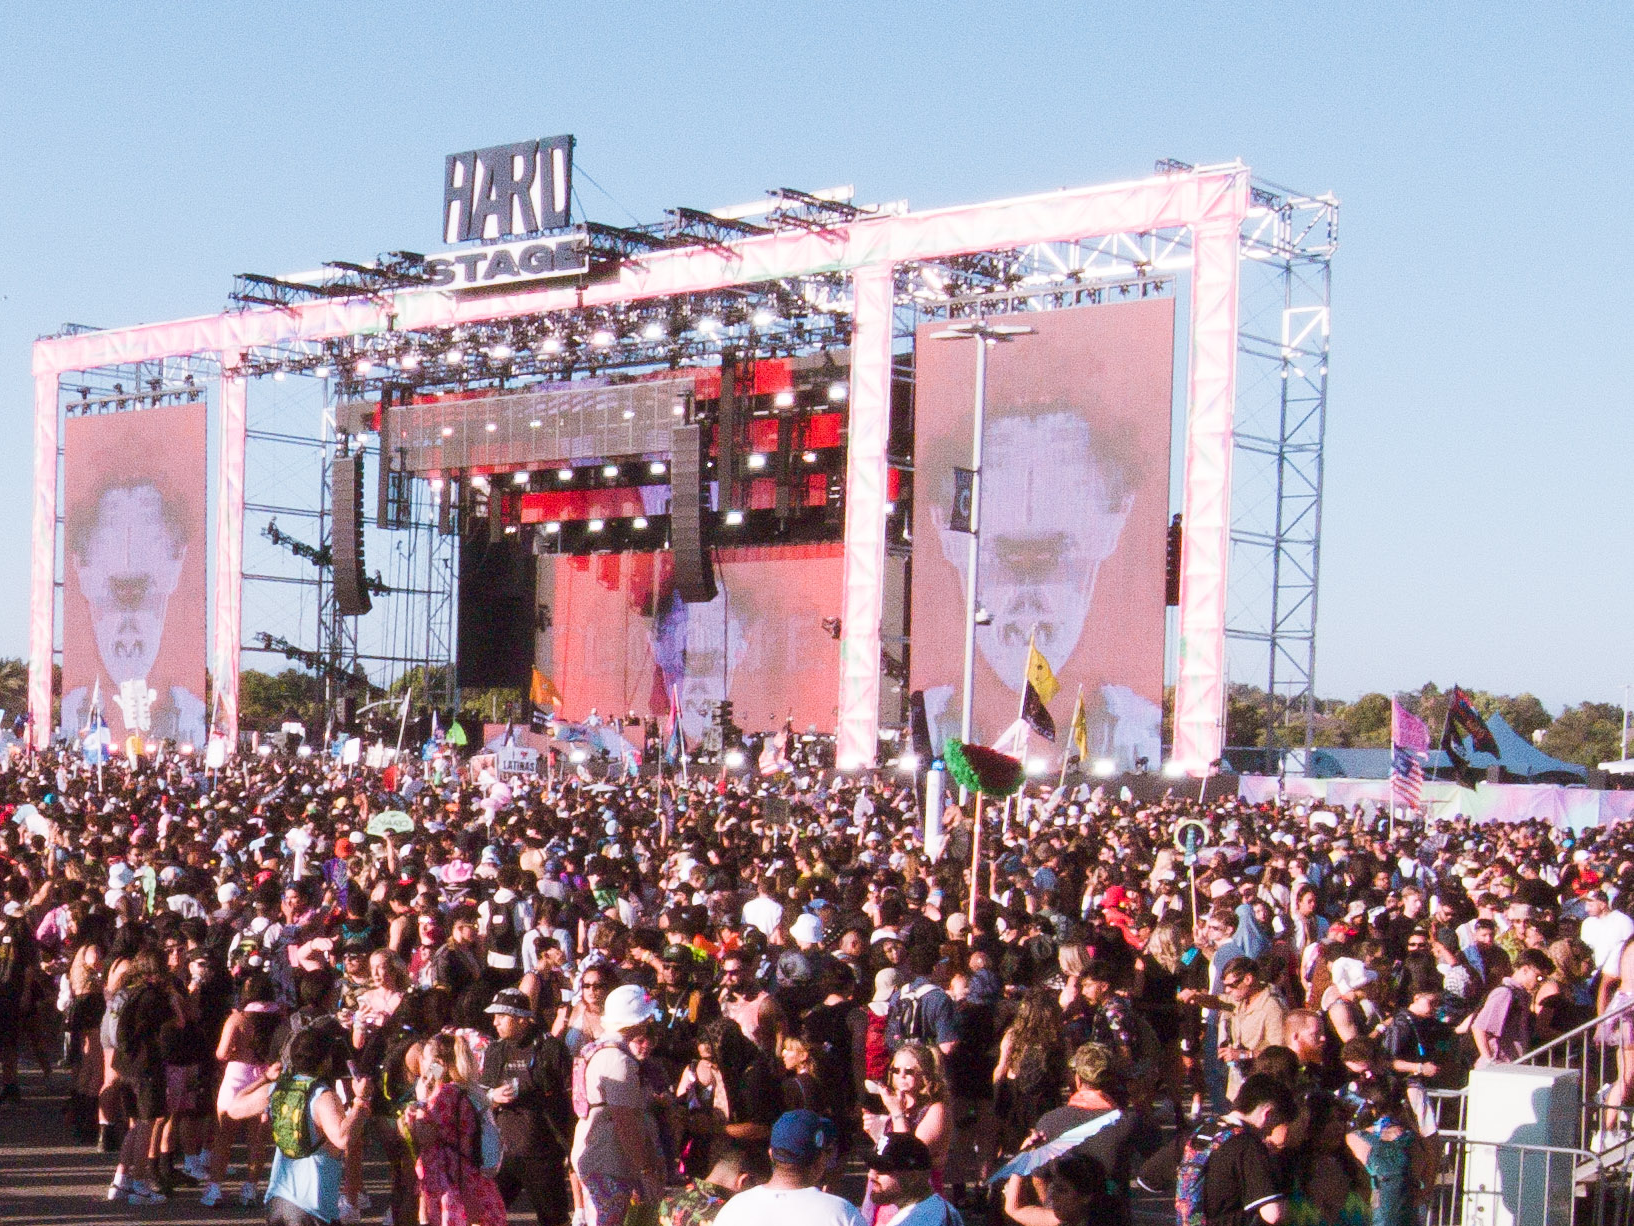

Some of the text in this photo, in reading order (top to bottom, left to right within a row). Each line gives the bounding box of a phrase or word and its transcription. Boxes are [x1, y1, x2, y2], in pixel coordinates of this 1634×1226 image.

[443, 134, 573, 243] HARD
[428, 239, 586, 287] STAGE
[503, 761, 535, 772] LATINAS
